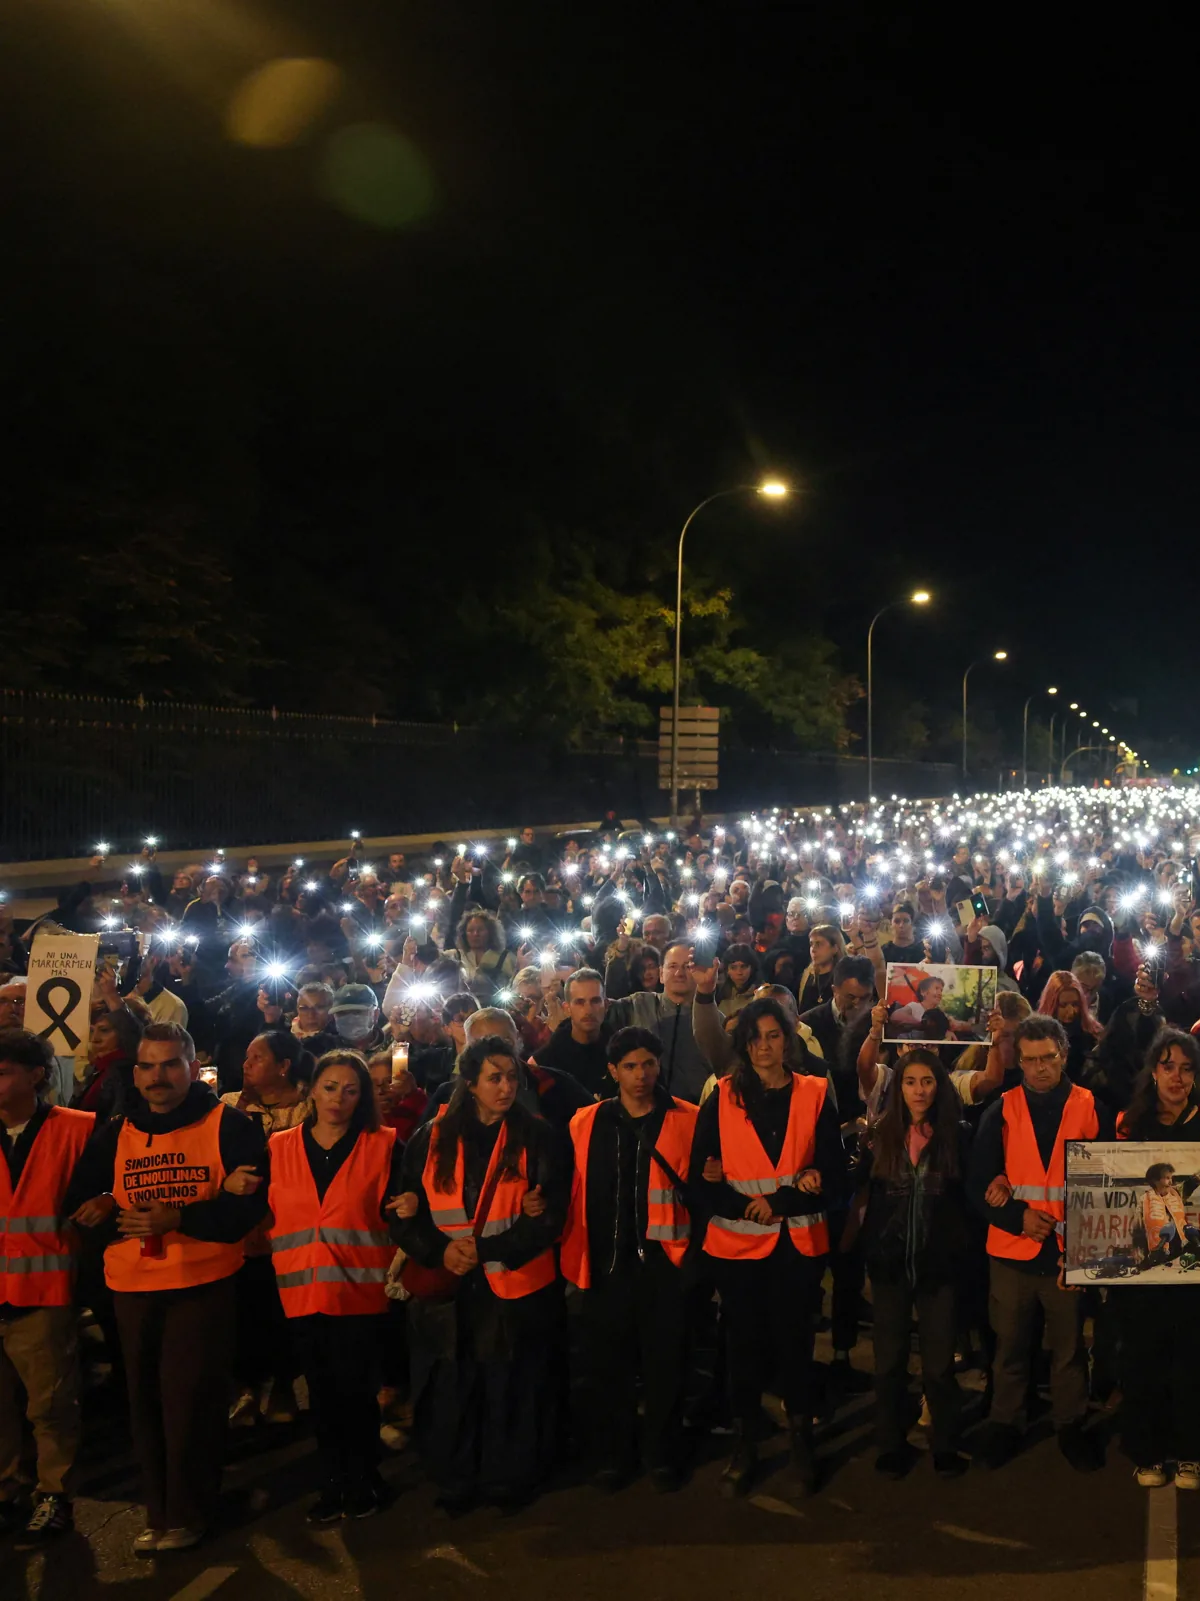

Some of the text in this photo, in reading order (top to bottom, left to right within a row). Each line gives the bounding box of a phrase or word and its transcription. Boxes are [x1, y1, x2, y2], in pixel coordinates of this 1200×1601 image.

[31, 960, 92, 969] MARICARMEN
[125, 1152, 186, 1171] SINDICATO
[125, 1168, 206, 1188] DE INQUILINAS
[128, 1185, 198, 1204] E INQUILINOS
[1104, 1192, 1137, 1209] VIDA
